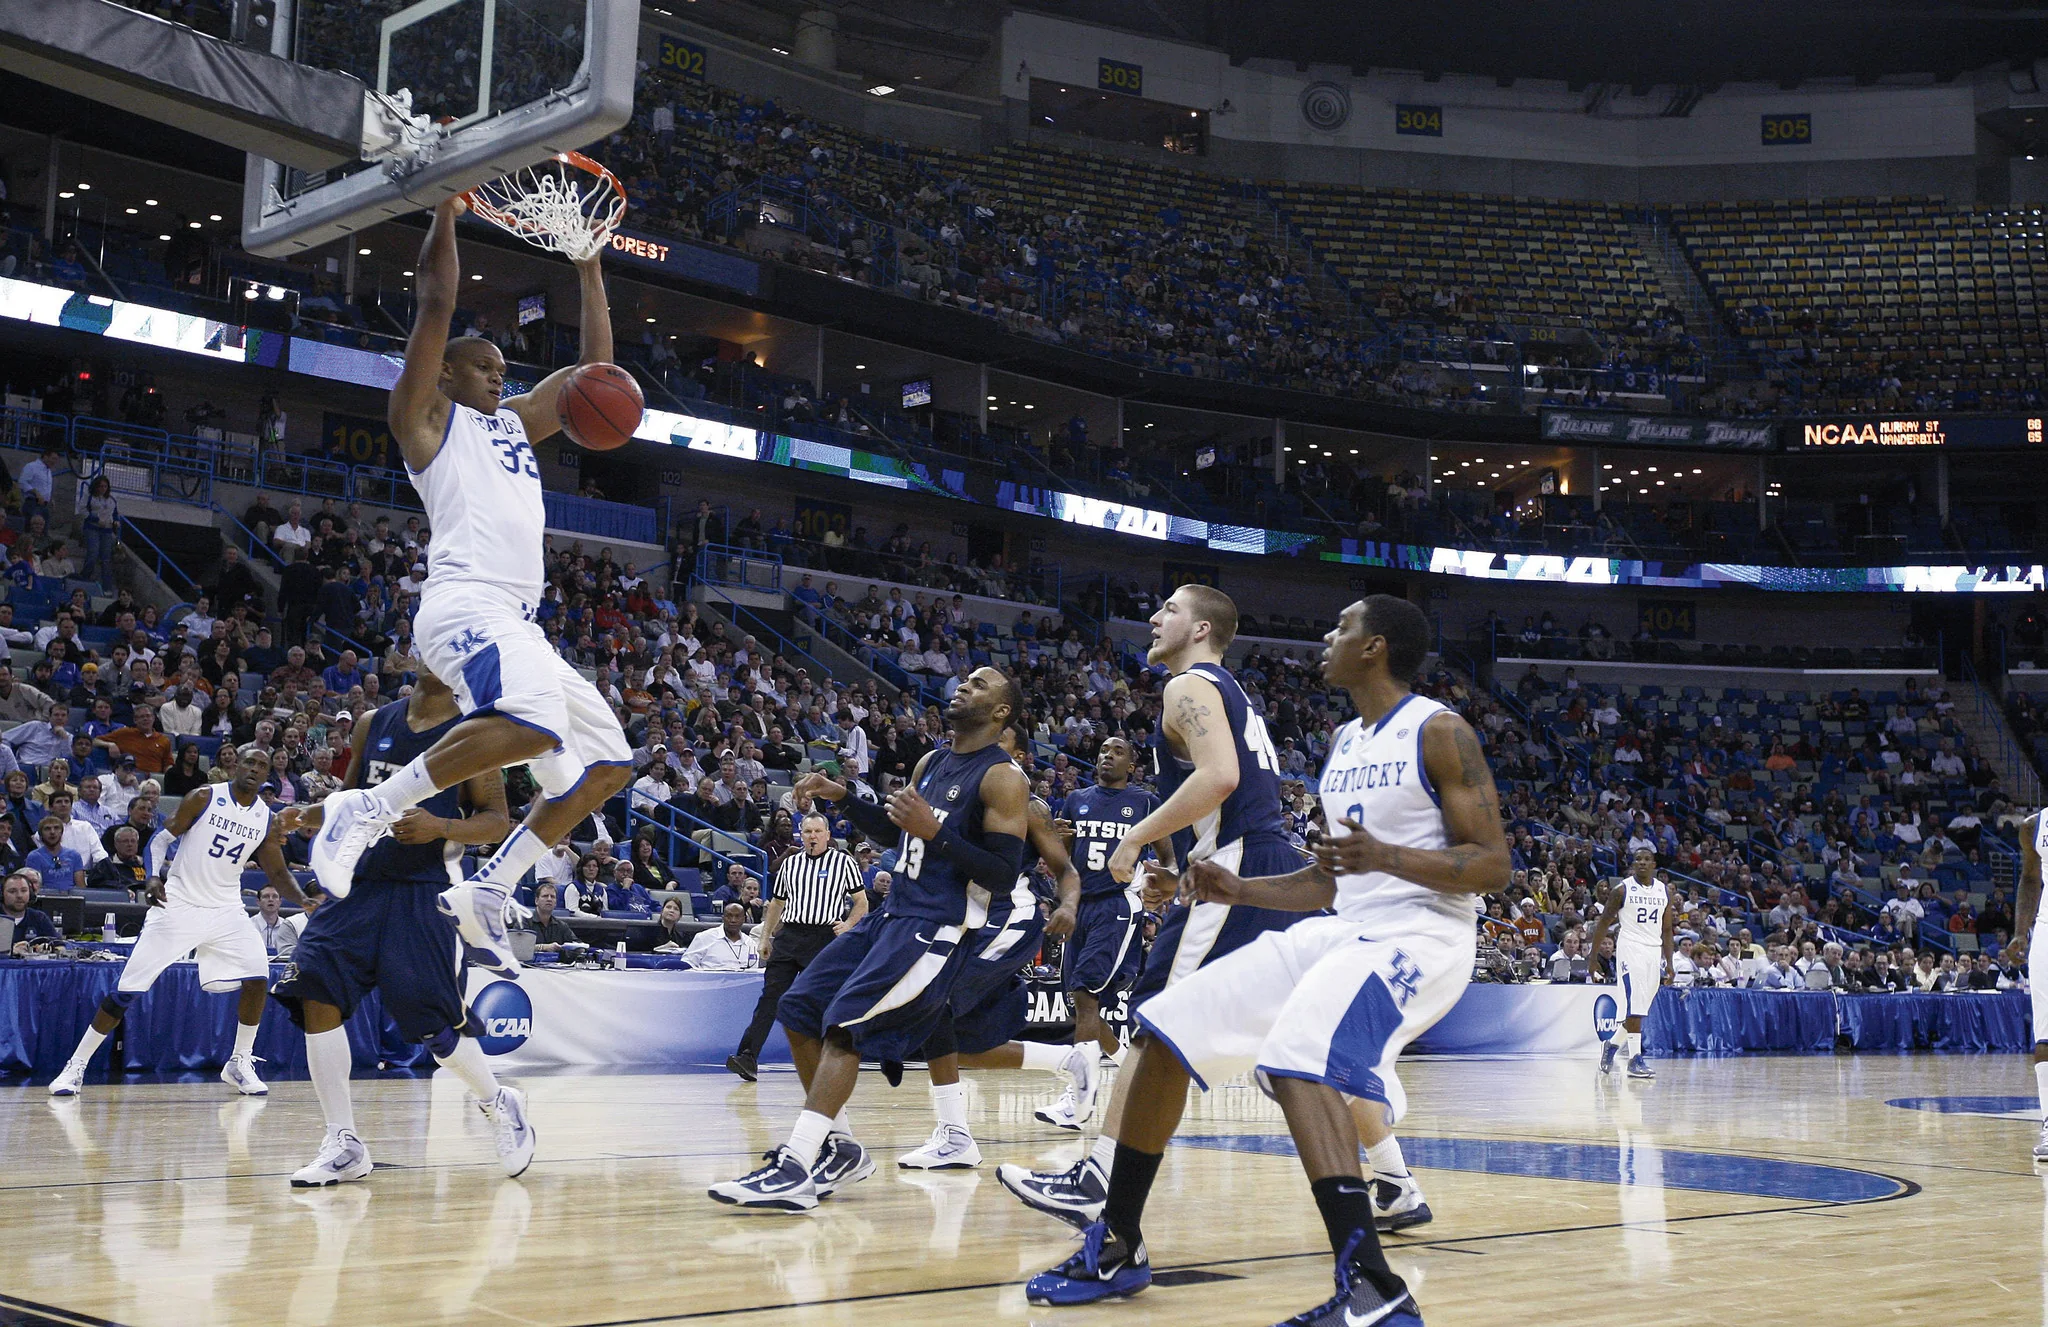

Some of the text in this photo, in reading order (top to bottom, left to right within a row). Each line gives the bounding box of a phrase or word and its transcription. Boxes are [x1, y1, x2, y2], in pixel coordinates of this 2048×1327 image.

[661, 43, 704, 76] 302
[1100, 64, 1142, 90] 303
[1398, 111, 1441, 131] 304
[1764, 119, 1810, 139] 305
[1529, 329, 1557, 341] 304
[1547, 413, 1614, 437] TULANE
[1627, 417, 1693, 441] TULANE
[1804, 423, 1879, 446] NCAA
[1880, 420, 1920, 434] MURRAY
[1925, 420, 1941, 434] ST
[332, 425, 390, 461] 101
[1880, 432, 1947, 447] VANDERBILT
[491, 438, 540, 480] 33
[561, 451, 580, 467] 101
[663, 471, 681, 485] 102
[1643, 607, 1692, 633] 104
[208, 813, 261, 841] KENTUCKY
[1075, 820, 1132, 840] ETSU
[208, 833, 246, 865] 54
[1086, 841, 1107, 871] 5
[717, 860, 723, 869] 8
[1629, 896, 1666, 907] KENTUCKY
[1637, 907, 1659, 924] 24
[1523, 928, 1539, 937] TEXAS
[1025, 991, 1069, 1022] CAA
